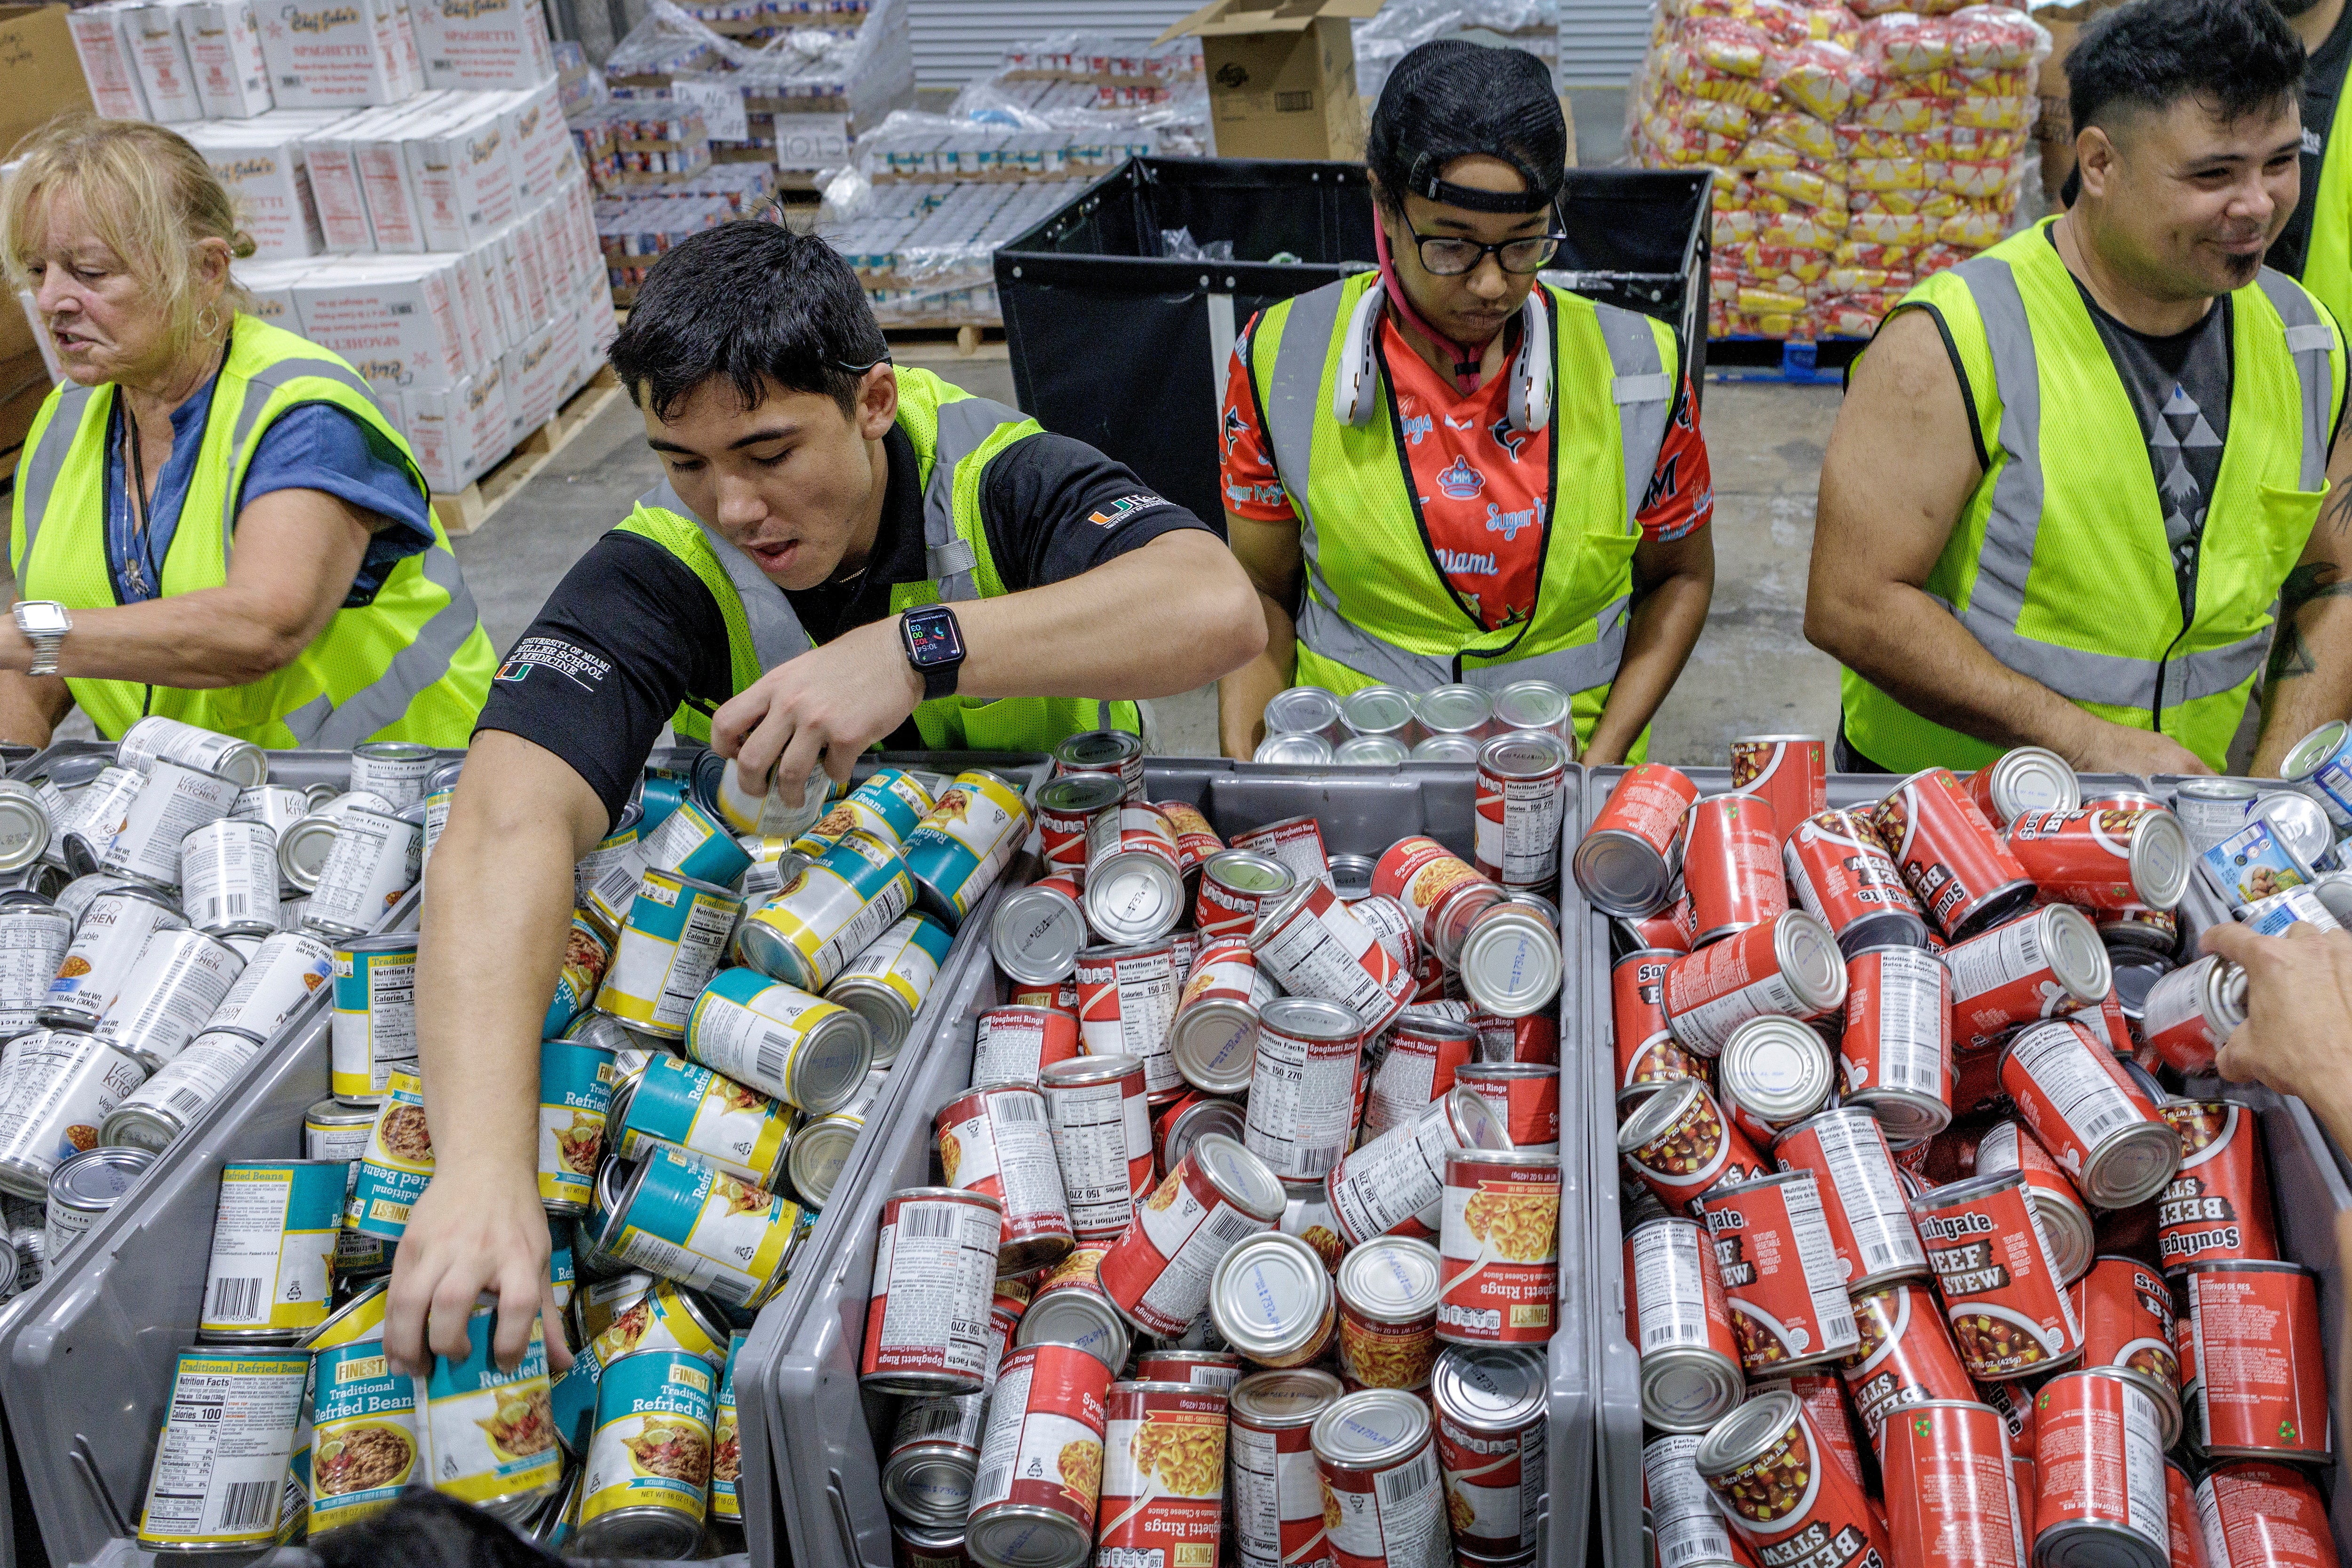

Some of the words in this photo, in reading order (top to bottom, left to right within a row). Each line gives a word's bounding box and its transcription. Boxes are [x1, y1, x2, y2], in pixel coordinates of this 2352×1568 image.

[445, 31, 516, 42] SPAGHETTI
[293, 45, 368, 56] SPAGHETTI
[1402, 413, 1433, 444] ings
[1452, 472, 1471, 484] MM
[1486, 502, 1534, 542] Sugar
[523, 637, 571, 650] UNIVERSITY
[570, 646, 582, 655] OF
[582, 652, 611, 673] MIAMI
[517, 645, 556, 658] MILLER
[557, 650, 604, 681] SCHOOL
[519, 652, 578, 676] MEDICINE
[177, 776, 217, 802] KITCHEN
[1506, 781, 1537, 790] Nutrition
[1538, 780, 1554, 789] Facts
[429, 805, 449, 814] Nutrition
[858, 793, 886, 816] Beans
[367, 819, 390, 829] Facts
[1274, 826, 1303, 840] Spaghetti
[1303, 824, 1315, 833] Rings
[612, 834, 634, 847] Beans
[1254, 837, 1272, 847] Facts
[696, 907, 720, 919] Nutrition
[686, 931, 711, 944] Calories
[713, 936, 723, 945] 100
[374, 967, 404, 976] Nutrition
[78, 990, 89, 998] Net
[89, 992, 102, 1002] Wt.
[1147, 986, 1160, 994] 150
[56, 994, 75, 1004] 10.6oz
[77, 998, 100, 1009] (300g)
[374, 994, 405, 1003] Calories
[992, 1015, 1022, 1024] Spaghetti
[1023, 1016, 1044, 1025] Rings
[1260, 1031, 1282, 1047] Nutrition
[1284, 1042, 1305, 1053] Facts
[1309, 1043, 1342, 1053] Spaghetti
[1343, 1041, 1358, 1051] Rings
[1388, 1036, 1416, 1050] Spaghetti
[1417, 1040, 1437, 1051] Rings
[1271, 1065, 1284, 1077] 150
[1287, 1070, 1302, 1080] 270
[1486, 1083, 1507, 1093] Rings
[564, 1092, 607, 1111] Refried
[363, 1164, 396, 1182] Beans
[1359, 1170, 1369, 1186] 270
[1511, 1172, 1529, 1180] (425g)
[1069, 1190, 1083, 1199] 270
[1086, 1189, 1101, 1198] 150
[1336, 1186, 1347, 1205] Facts
[1784, 1186, 1806, 1194] Nutrition
[1072, 1218, 1093, 1226] Facts
[1095, 1213, 1131, 1225] Nutrition
[1375, 1205, 1392, 1227] Calories
[1013, 1220, 1035, 1231] Rings
[1345, 1209, 1370, 1242] Nutrition
[1634, 1228, 1661, 1243] Nutrition
[1752, 1230, 1777, 1243] TEXTURED
[1755, 1239, 1781, 1251] VEGETABLE
[1757, 1248, 1779, 1258] PROTEIN
[1758, 1256, 1781, 1267] PRODUCT
[1762, 1265, 1778, 1275] ADDED
[1504, 1272, 1528, 1281] Cheese
[1943, 1267, 2000, 1295] STEW
[1480, 1283, 1521, 1300] Rings
[1511, 1307, 1548, 1325] FINEST
[951, 1321, 965, 1331] 270
[969, 1324, 980, 1336] 150
[878, 1355, 899, 1365] Rings
[902, 1354, 943, 1366] Spaghetti
[947, 1356, 968, 1366] Facts
[1015, 1354, 1035, 1366] Rings
[180, 1360, 233, 1373] Traditional
[236, 1363, 278, 1373] Refried
[281, 1363, 304, 1374] Beans
[338, 1359, 386, 1380] FINEST
[179, 1376, 206, 1386] Nutrition
[207, 1377, 230, 1386] Facts
[672, 1366, 708, 1389] FINEST
[329, 1380, 395, 1400] Traditional
[661, 1385, 710, 1408] Traditional
[633, 1398, 691, 1417] Refried
[1180, 1401, 1197, 1409] (425g)
[172, 1410, 196, 1420] Calories
[202, 1409, 221, 1420] 100
[315, 1400, 363, 1423] Refried
[1148, 1508, 1168, 1517] Sauce
[1170, 1509, 1194, 1517] Cheese
[1144, 1519, 1185, 1537] Rings
[1252, 1543, 1277, 1552] Calories
[1763, 1523, 1825, 1566] STEW
[1177, 1546, 1212, 1564] FINEST
